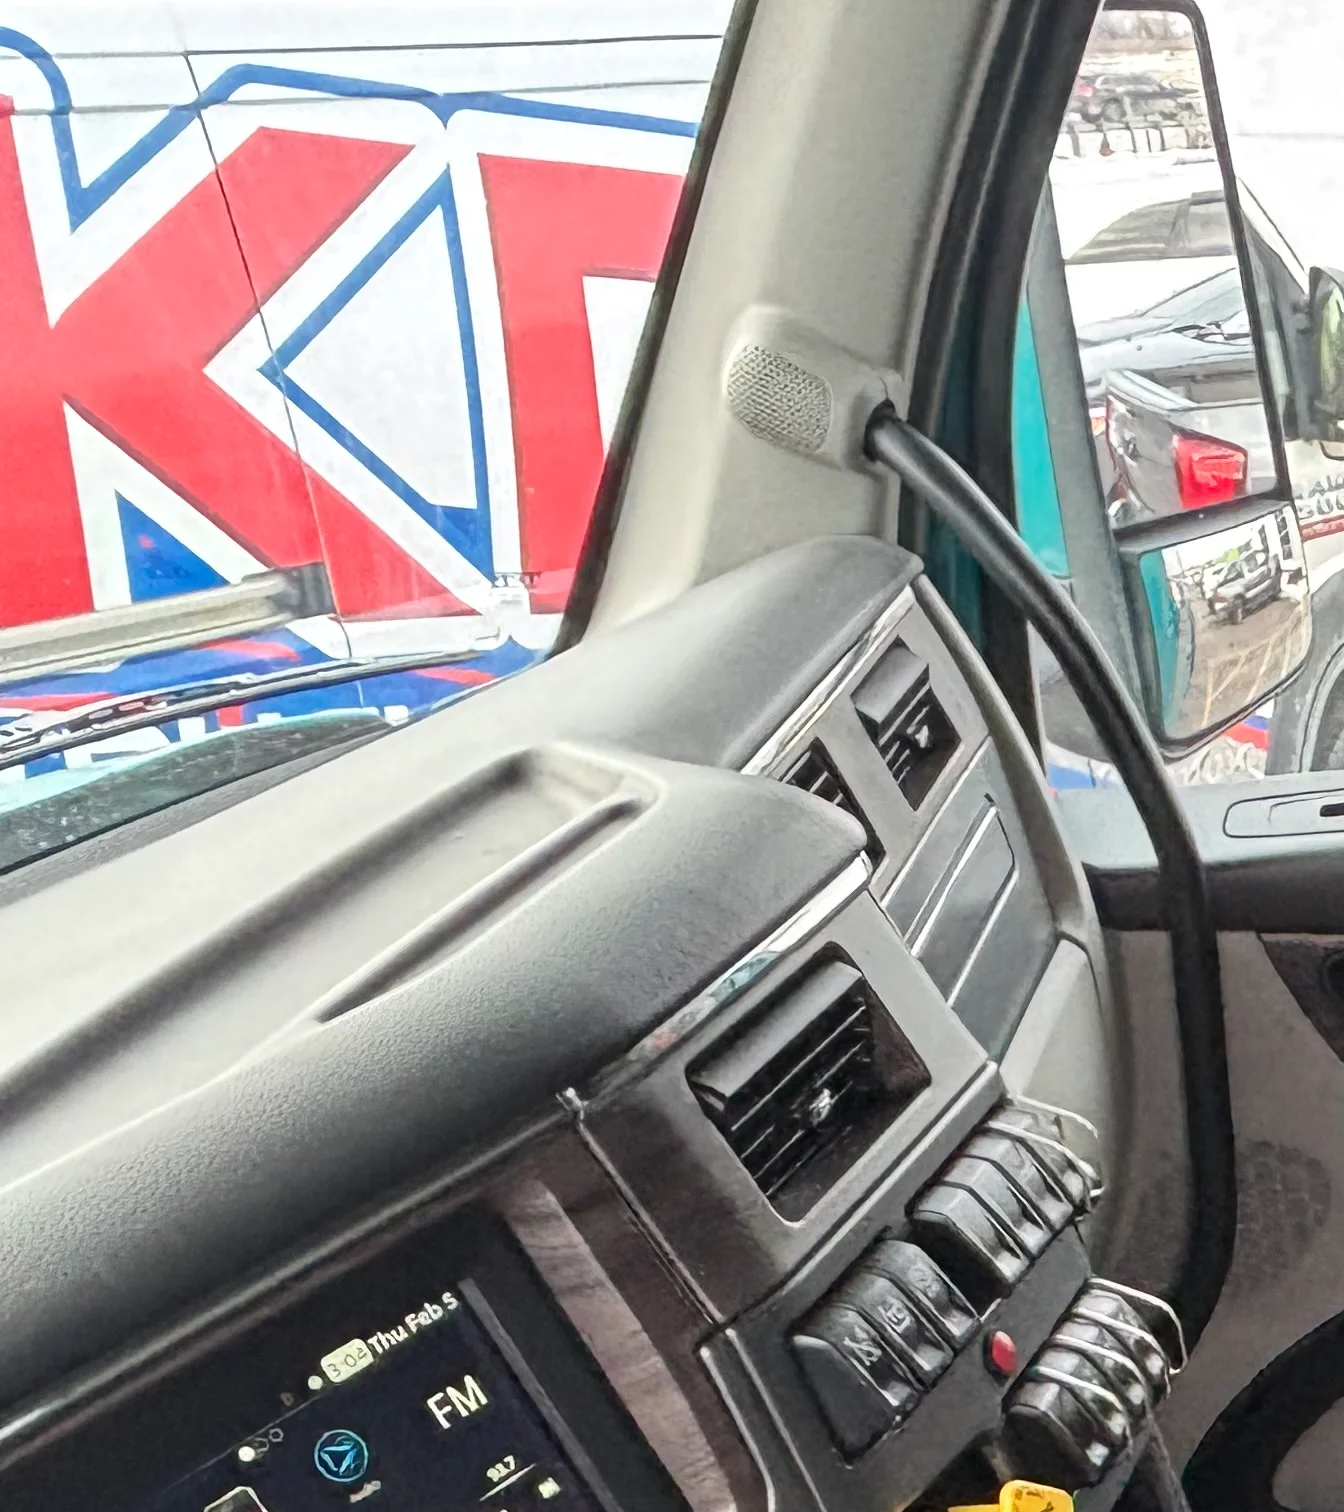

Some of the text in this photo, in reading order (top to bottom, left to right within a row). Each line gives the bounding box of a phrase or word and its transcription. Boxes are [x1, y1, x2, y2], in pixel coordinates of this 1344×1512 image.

[367, 1325, 408, 1355] Thu
[405, 1302, 444, 1334] Feb
[427, 1374, 489, 1430] FM
